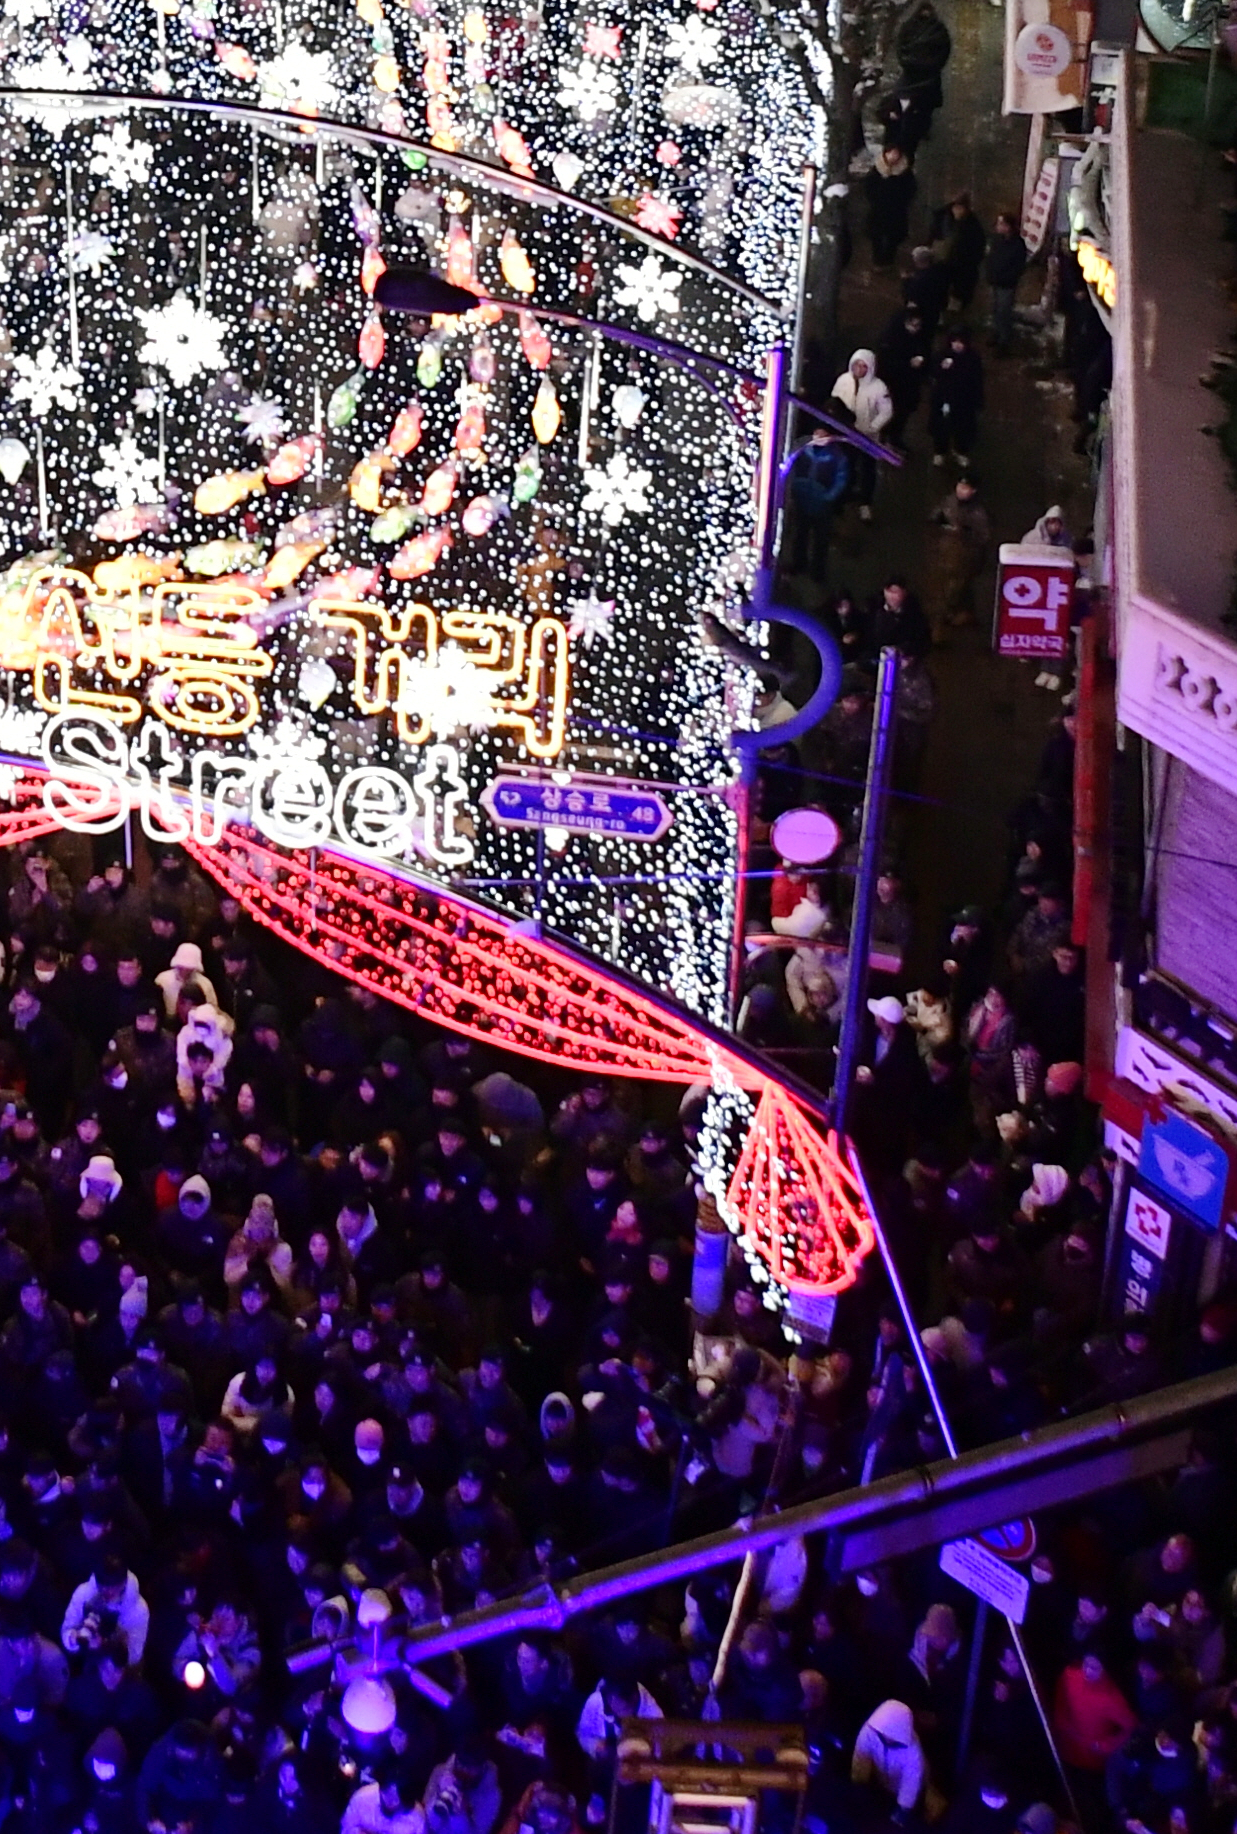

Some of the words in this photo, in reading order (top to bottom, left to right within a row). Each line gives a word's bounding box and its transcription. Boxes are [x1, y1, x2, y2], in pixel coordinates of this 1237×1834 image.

[1002, 575, 1070, 633] 약
[999, 633, 1064, 652] 십자약국
[40, 712, 475, 867] Street
[540, 787, 613, 814] 상승로
